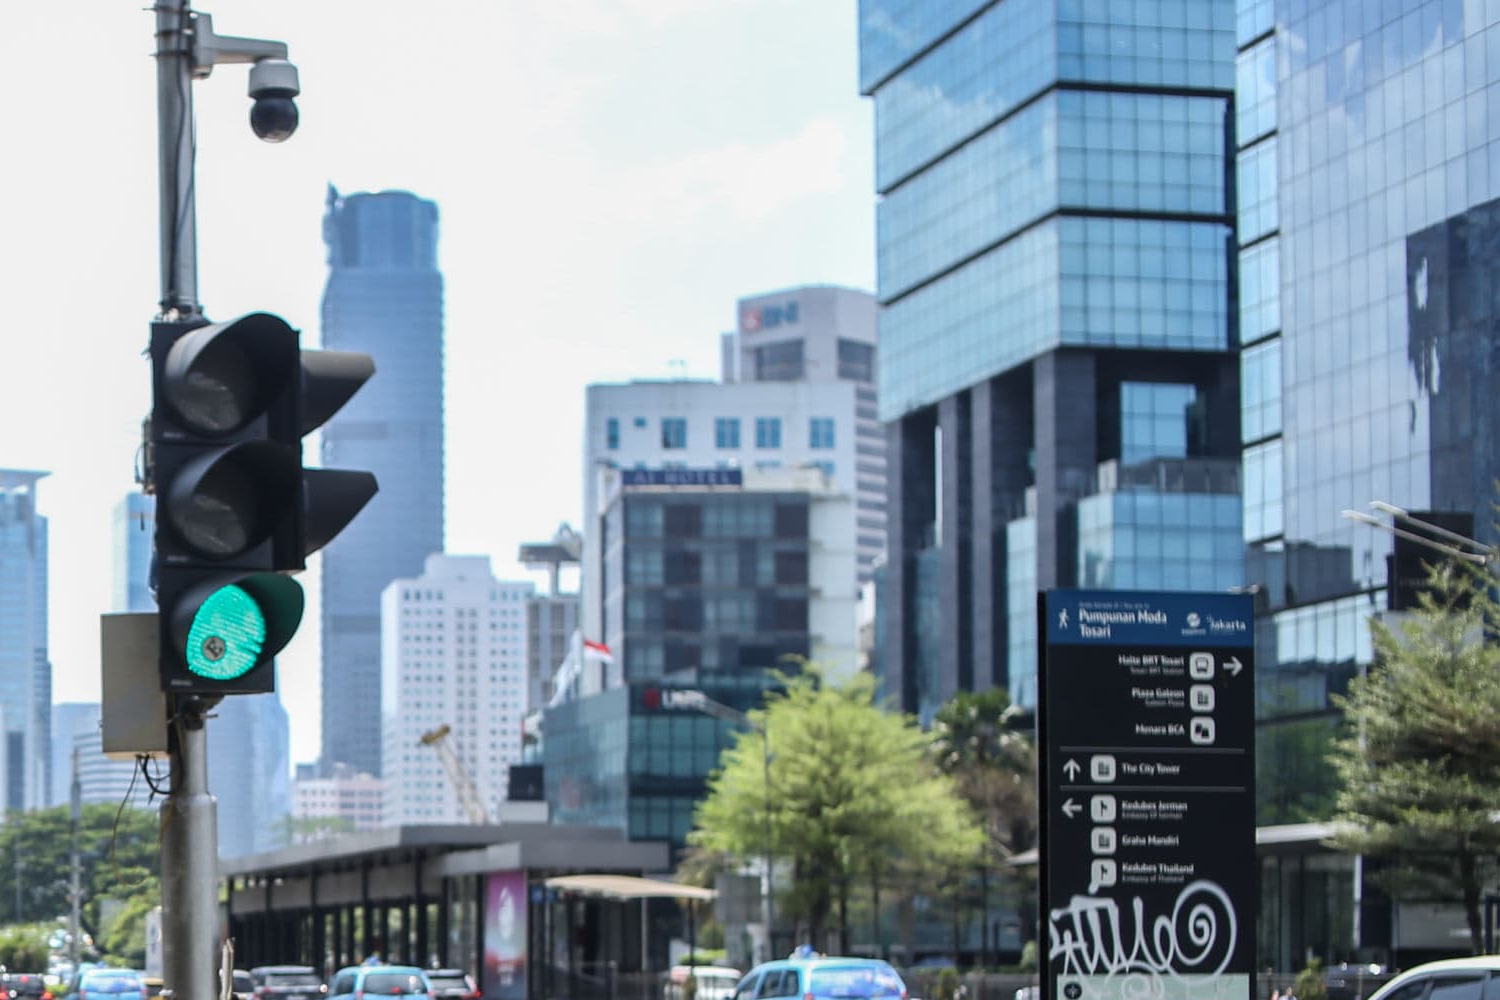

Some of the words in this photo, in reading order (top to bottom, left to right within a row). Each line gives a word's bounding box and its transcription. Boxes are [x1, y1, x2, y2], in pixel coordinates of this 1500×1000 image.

[1078, 609, 1136, 624] Pumpunan
[1138, 609, 1168, 624] Moda
[1079, 624, 1111, 639] Tosari
[1131, 687, 1154, 699] Plaza
[1135, 723, 1167, 736] Menara
[1168, 723, 1185, 736] BCA
[1122, 762, 1138, 774] The
[1139, 762, 1155, 777] City
[1156, 762, 1180, 774] Tower
[1122, 834, 1147, 846] Graha
[1148, 834, 1180, 846] Mandiri
[1158, 863, 1195, 874] Thailand
